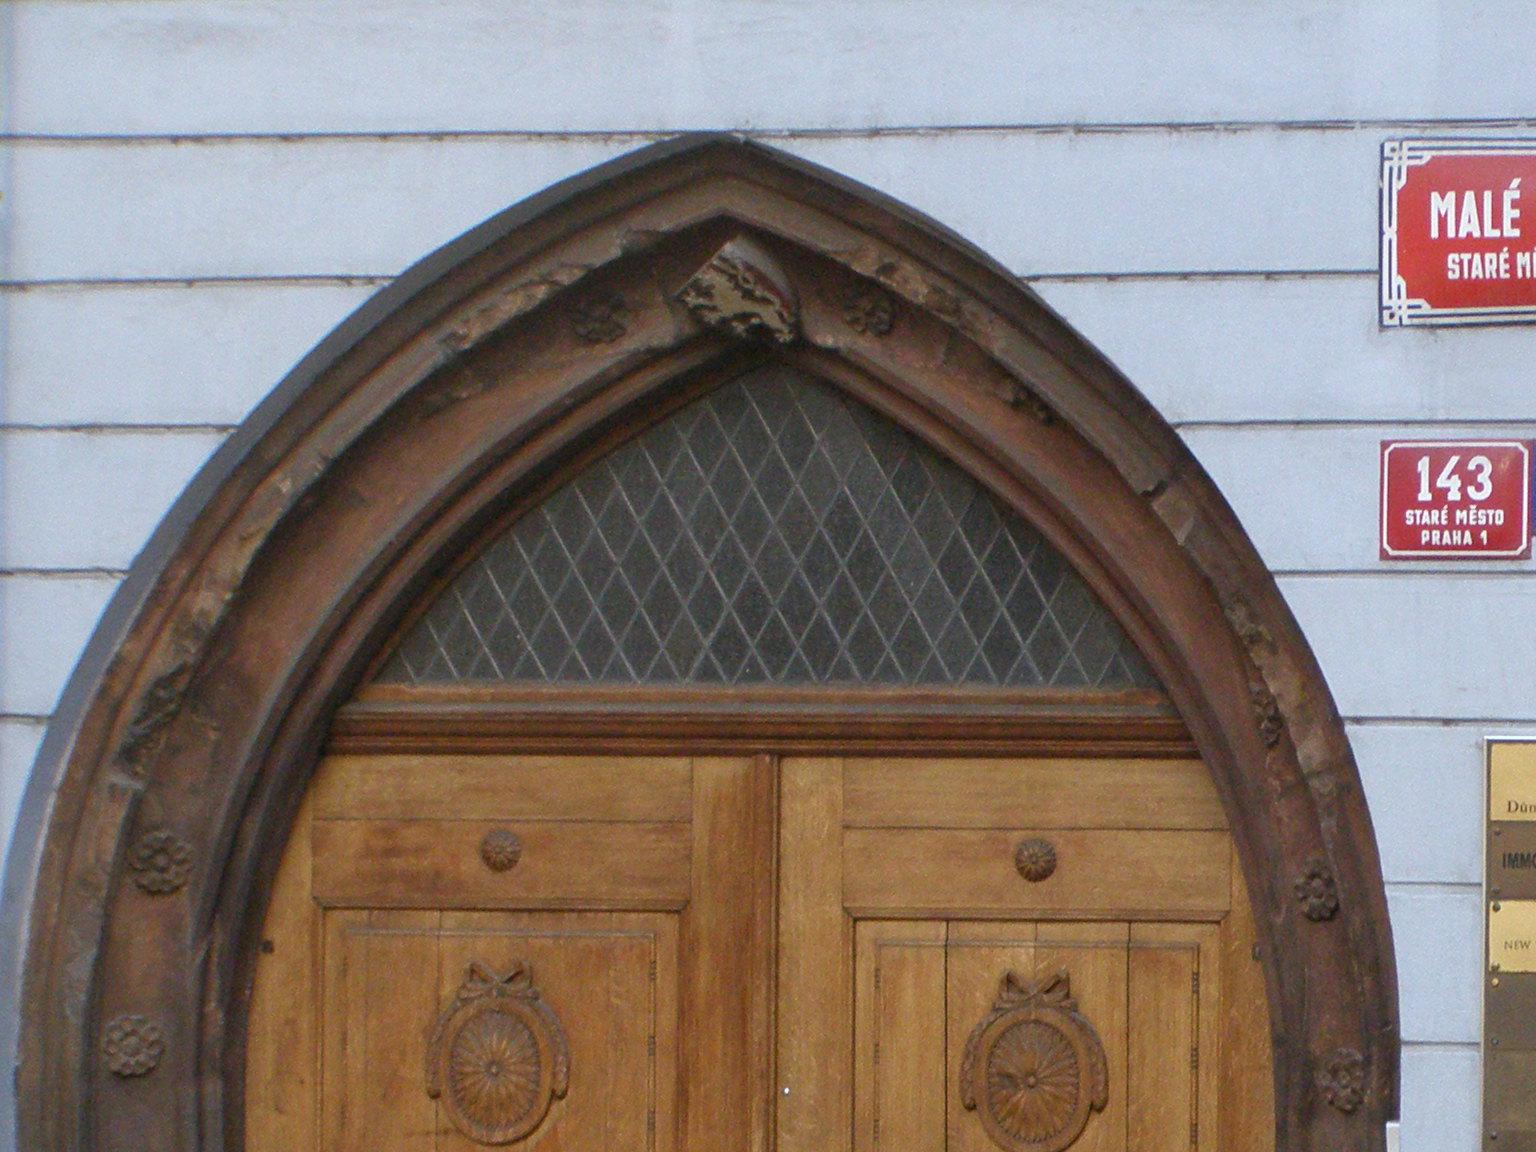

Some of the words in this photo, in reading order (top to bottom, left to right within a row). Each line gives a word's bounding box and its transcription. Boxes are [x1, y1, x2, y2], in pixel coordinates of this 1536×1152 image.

[1430, 178, 1521, 239] MALÉ
[1447, 247, 1510, 279] STARÉ
[1417, 455, 1493, 501] 143
[1405, 505, 1448, 525] STARÉ
[1455, 505, 1504, 525] MĚSTO
[1421, 530, 1472, 546] PRAHA
[1480, 530, 1488, 545] 1
[1504, 940, 1532, 950] NEW
